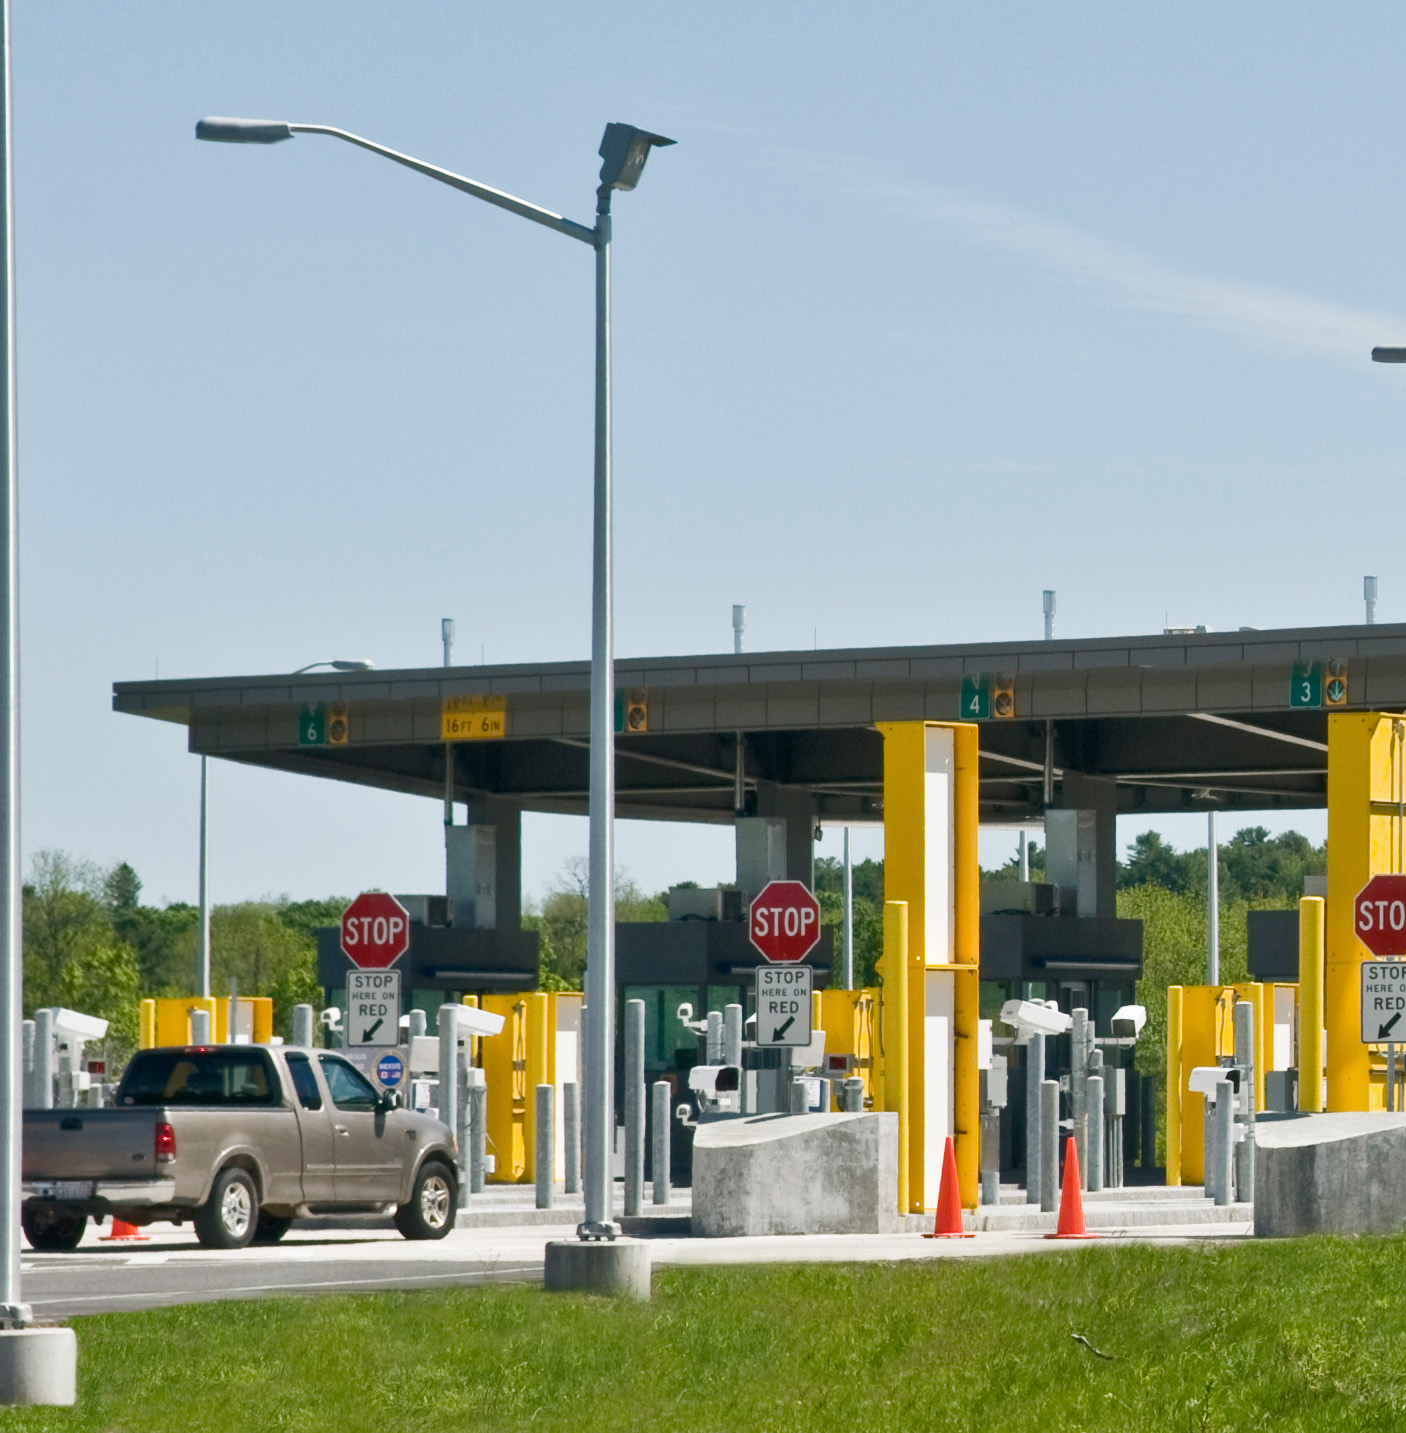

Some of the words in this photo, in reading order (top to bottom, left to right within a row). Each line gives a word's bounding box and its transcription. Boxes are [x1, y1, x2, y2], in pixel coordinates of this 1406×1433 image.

[1301, 681, 1311, 702] 3
[969, 694, 980, 714] 4
[307, 722, 317, 741] 6
[755, 907, 815, 937] STOP
[345, 917, 403, 946] STOP
[355, 975, 393, 988] STOP
[764, 971, 805, 984] STOP
[762, 988, 787, 997] HERE
[793, 988, 807, 997] ON
[1366, 984, 1393, 993] HERE
[352, 992, 376, 1000] HERE
[382, 992, 395, 1000] ON
[359, 1004, 387, 1016] RED
[769, 1001, 799, 1014] RED
[1374, 997, 1405, 1010] RED
